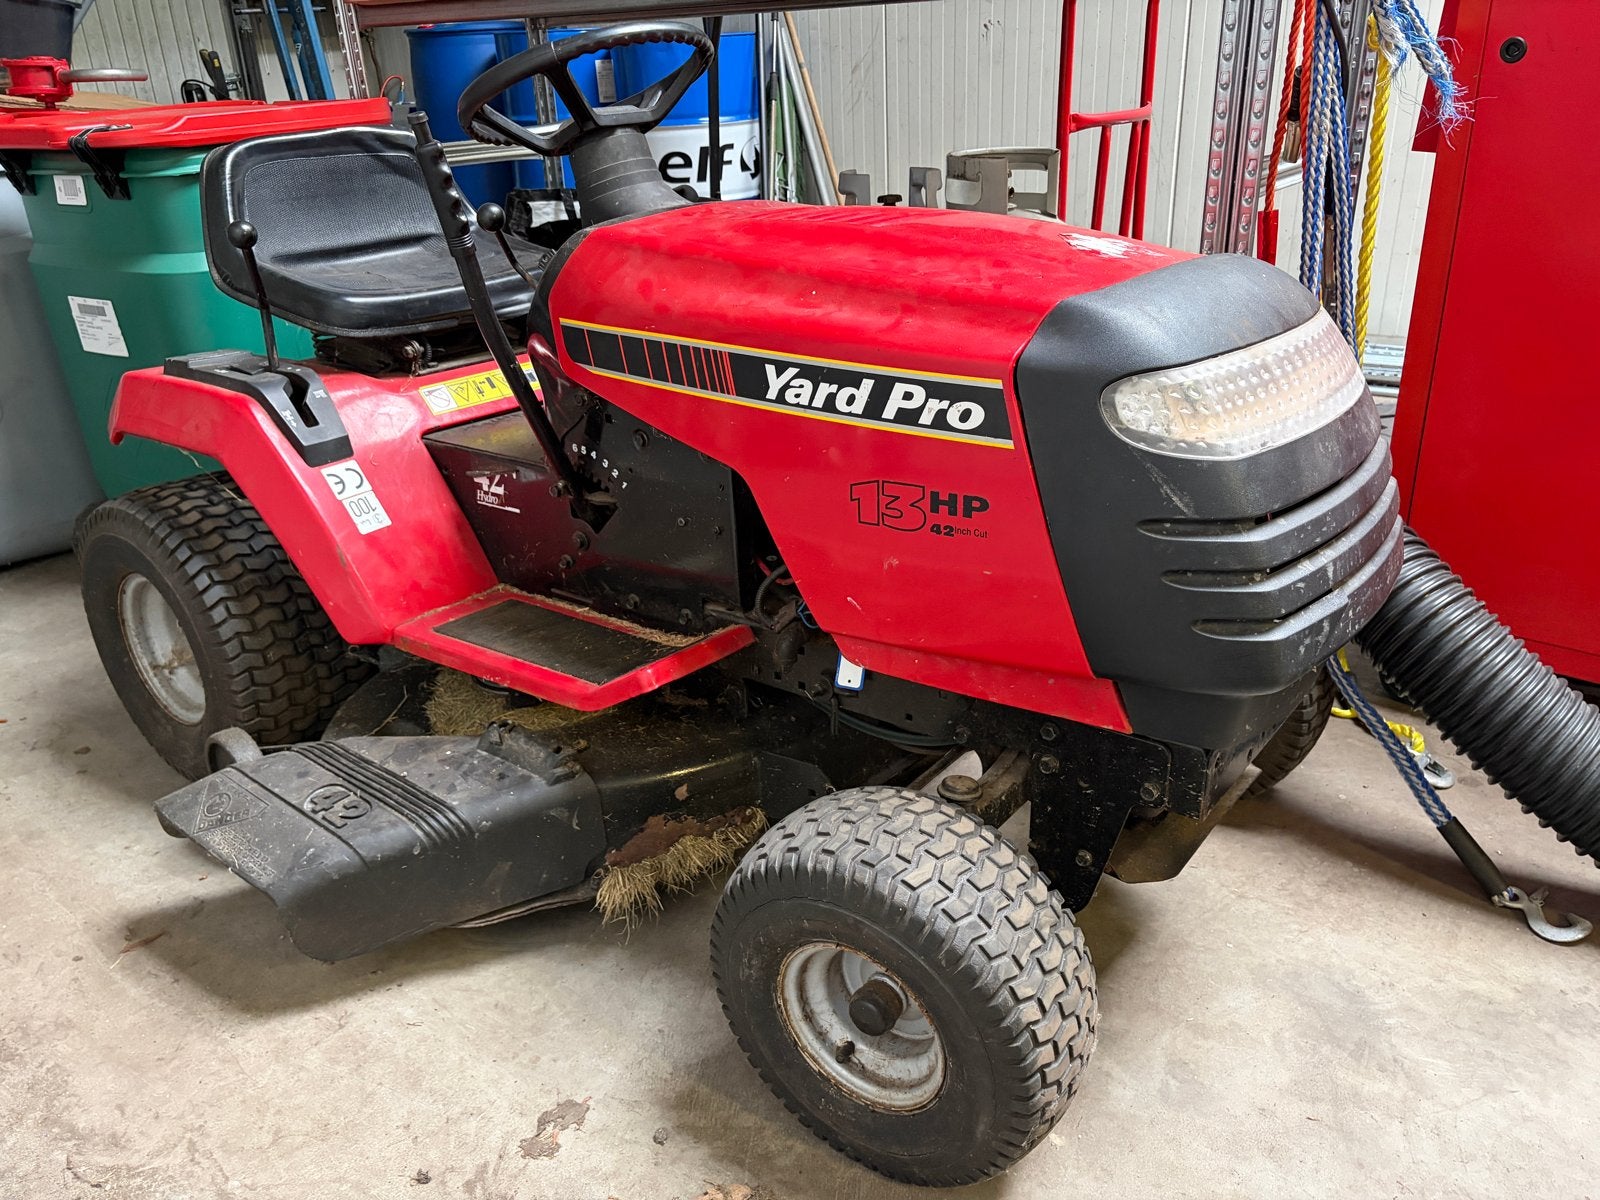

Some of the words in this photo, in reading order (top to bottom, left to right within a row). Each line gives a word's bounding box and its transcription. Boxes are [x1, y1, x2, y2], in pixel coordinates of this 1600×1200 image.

[658, 143, 734, 184] elf
[765, 363, 875, 414] Yard
[881, 382, 985, 430] Pro
[326, 468, 364, 495] CE
[572, 443, 579, 453] 6
[580, 445, 587, 455] 5
[590, 450, 597, 460] 4
[602, 458, 609, 468] 3
[611, 468, 619, 479] 2
[621, 481, 628, 489] 1
[349, 496, 377, 518] 100
[477, 489, 499, 505] Hydro
[850, 480, 927, 532] 13
[930, 491, 990, 519] HP
[930, 523, 955, 538] 42
[973, 528, 989, 539] Cut
[309, 787, 371, 829] 42
